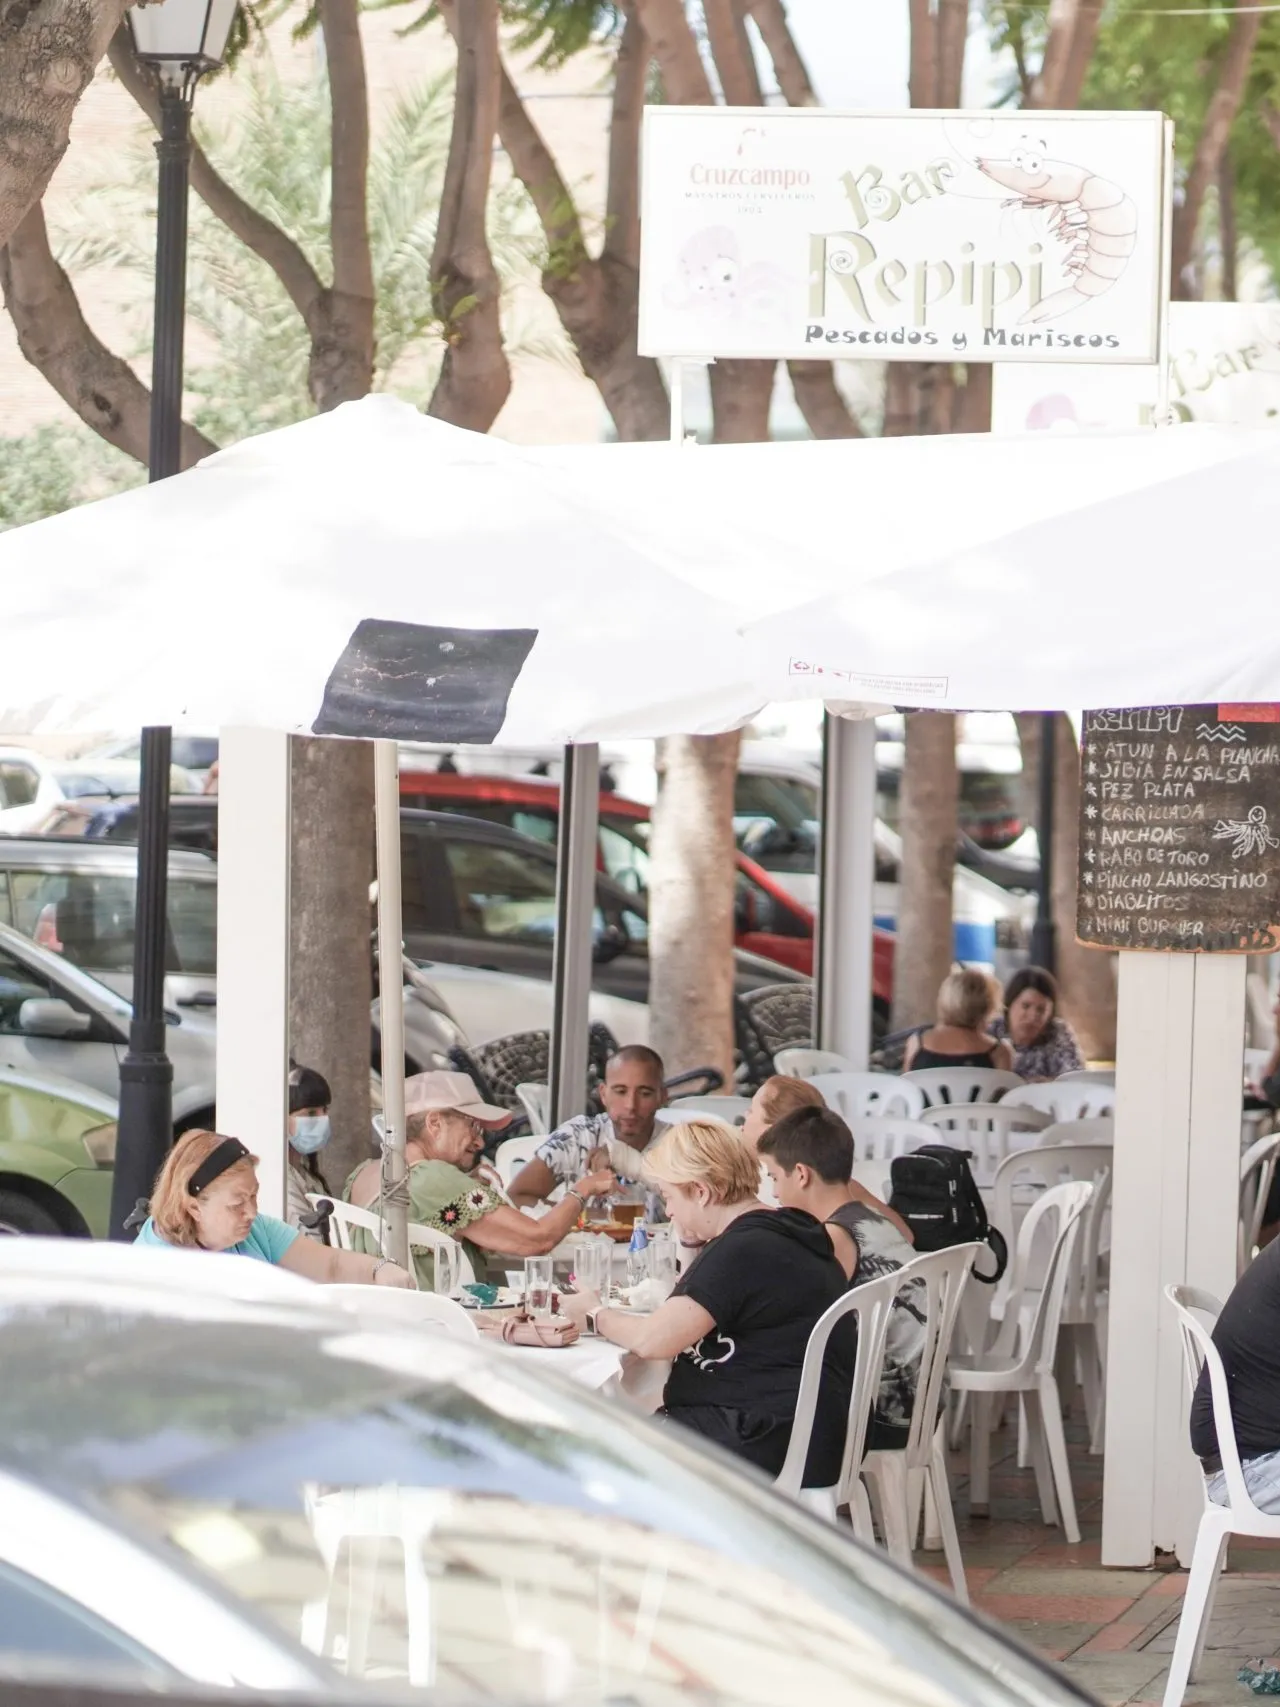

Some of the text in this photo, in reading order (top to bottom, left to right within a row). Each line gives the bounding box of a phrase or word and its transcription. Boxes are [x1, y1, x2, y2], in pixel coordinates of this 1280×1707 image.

[690, 163, 810, 190] Cruzcampo
[838, 157, 956, 230] Bar
[808, 230, 1044, 328] Repipi
[805, 324, 1120, 350] Pescados y Mariscos
[1104, 743, 1155, 758] ATUN
[1166, 744, 1178, 762] A
[1162, 763, 1189, 780] EN
[1192, 765, 1251, 783] SALSA
[1101, 781, 1196, 800] PEZ PLATA
[1101, 804, 1205, 822] CARRILLADA
[1101, 826, 1186, 846] ANCHOAS
[1099, 848, 1209, 866] RABO DE TORO
[1097, 869, 1267, 890] PINCHO LANGOSTINO
[1097, 890, 1188, 911] DIABLITOS
